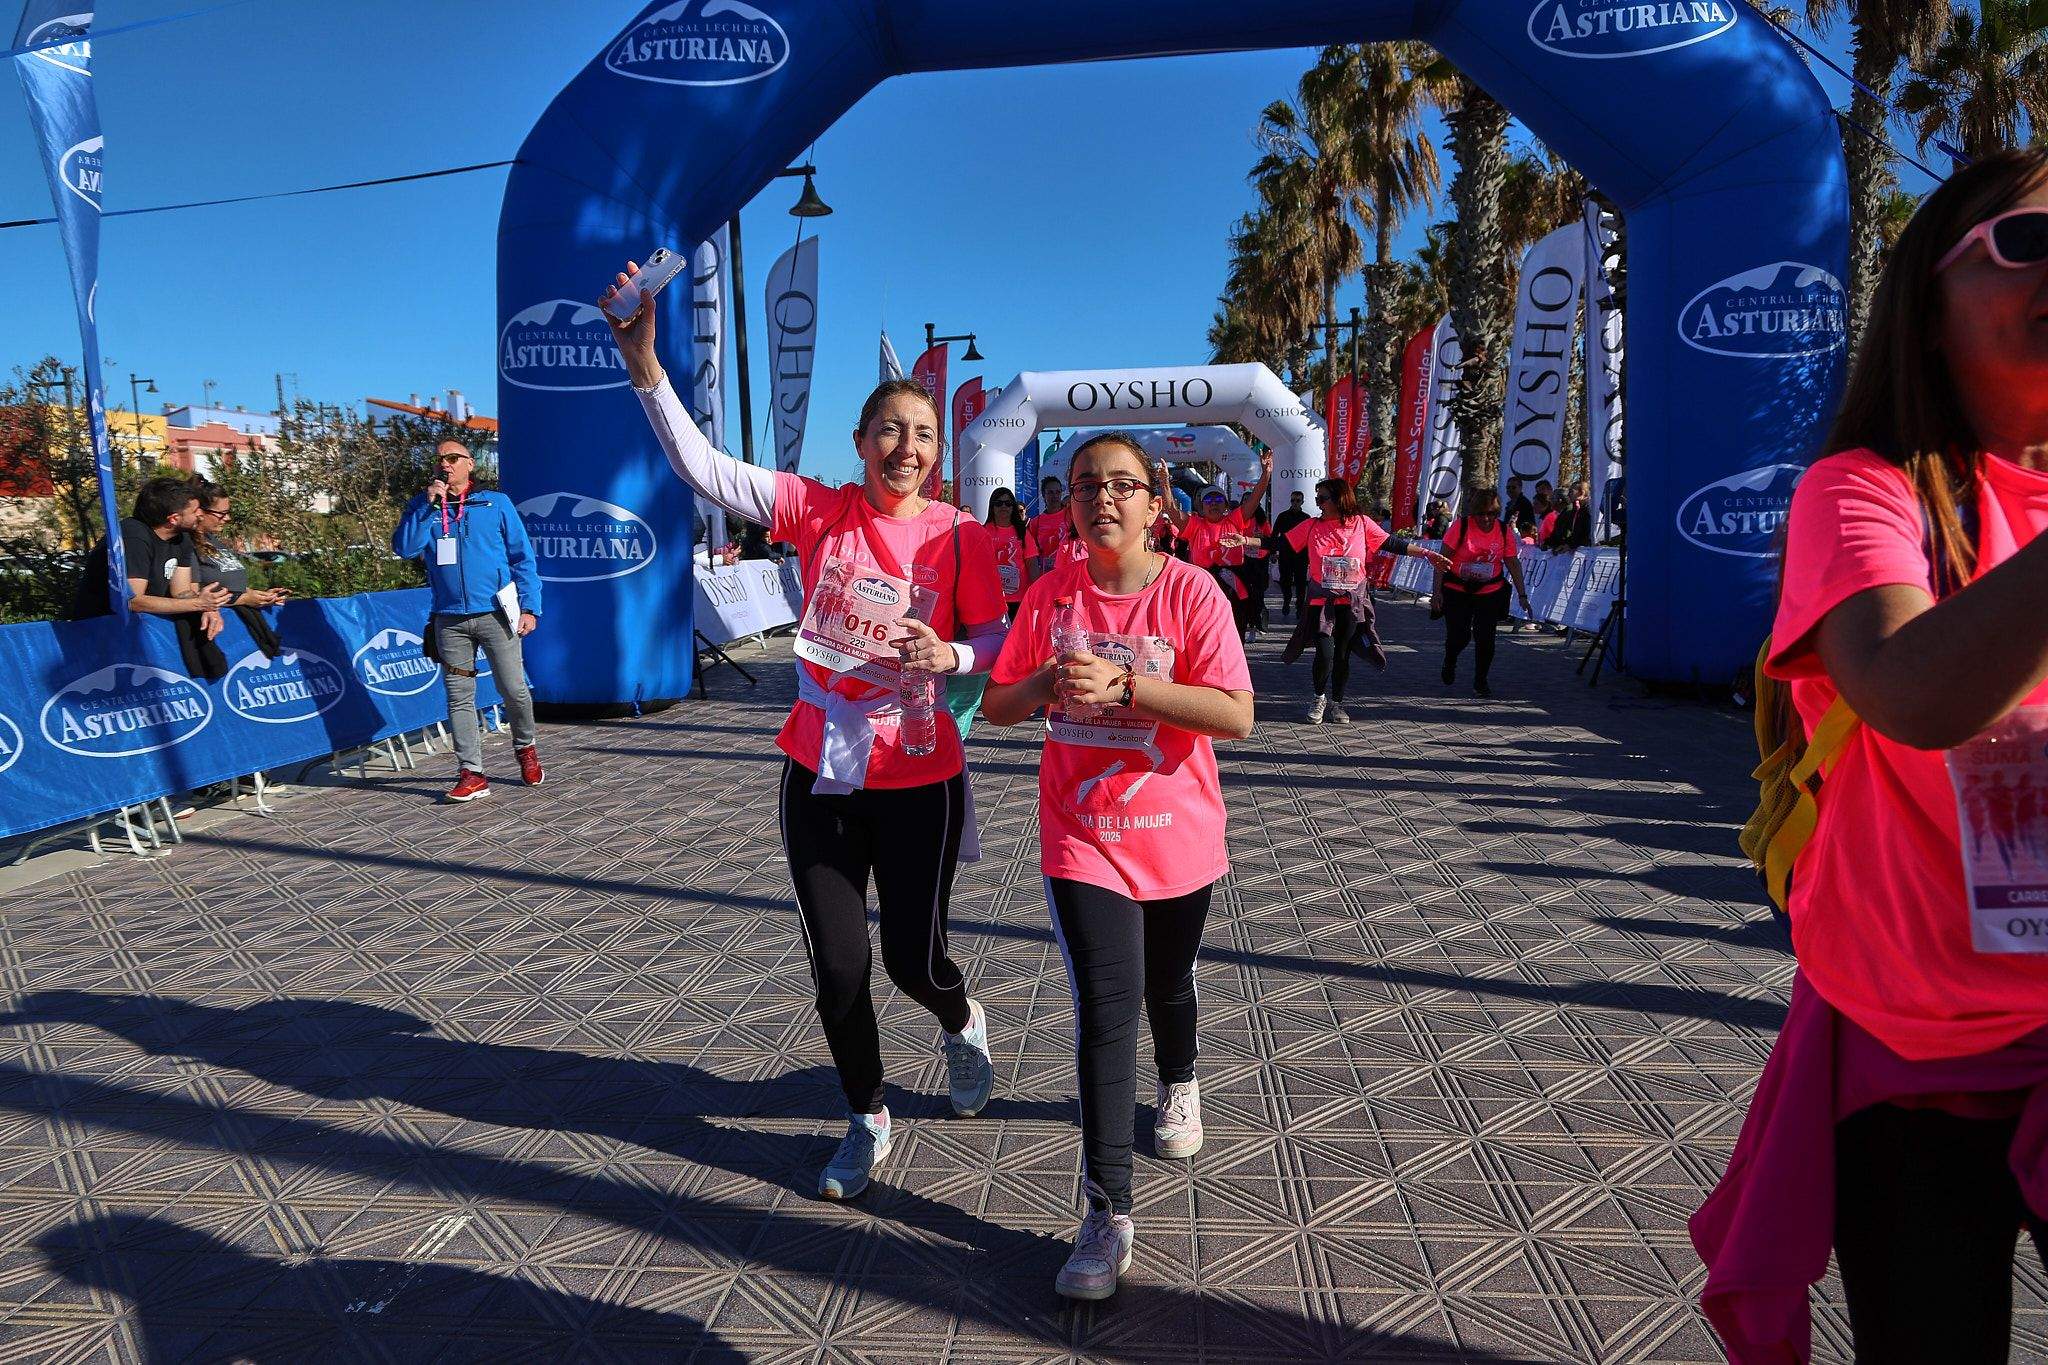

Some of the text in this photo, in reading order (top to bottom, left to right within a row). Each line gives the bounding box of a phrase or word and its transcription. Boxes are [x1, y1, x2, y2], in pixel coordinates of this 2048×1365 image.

[644, 23, 768, 38] CENTRAL LECHERA
[1544, 1, 1728, 42] ASTURIANA
[614, 36, 775, 66] ASTURIANA
[1726, 295, 1795, 308] CENTRAL
[518, 331, 571, 342] CENTRAL
[503, 336, 627, 370] ASTURIAN
[774, 290, 815, 473] YSHO
[1510, 266, 1574, 482] OYSHO
[1067, 377, 1213, 412] OYSHO
[1410, 349, 1432, 437] Santander
[982, 418, 1025, 428] OYSHO
[1255, 407, 1300, 419] OYSHO
[1336, 395, 1348, 460] Santander
[964, 476, 1004, 487] OYSHO
[1280, 468, 1322, 479] OYSHO
[1724, 497, 1790, 507] CENTRAL
[527, 523, 639, 534] ENTRAL LECHERA
[530, 535, 645, 560] TURIANA
[700, 573, 748, 608] OYSHO
[762, 566, 802, 596] OYSHO
[855, 582, 896, 603] ASTURIANA
[844, 614, 889, 642] 016
[813, 635, 837, 651] CARRERA
[851, 648, 870, 661] MUJER
[850, 637, 866, 649] 229
[806, 645, 841, 665] OYSHO
[249, 671, 289, 684] CENTRAL
[364, 656, 437, 685] ASTURIANA
[861, 666, 897, 684] Santander
[80, 684, 192, 711] CENTRAL LECHERA
[237, 675, 340, 711] ASTURIANA
[61, 697, 206, 744] ASTURIANA
[1059, 727, 1094, 740] OYSHO
[1098, 813, 1173, 830] DE LA MUJER
[1099, 831, 1121, 842] 2025
